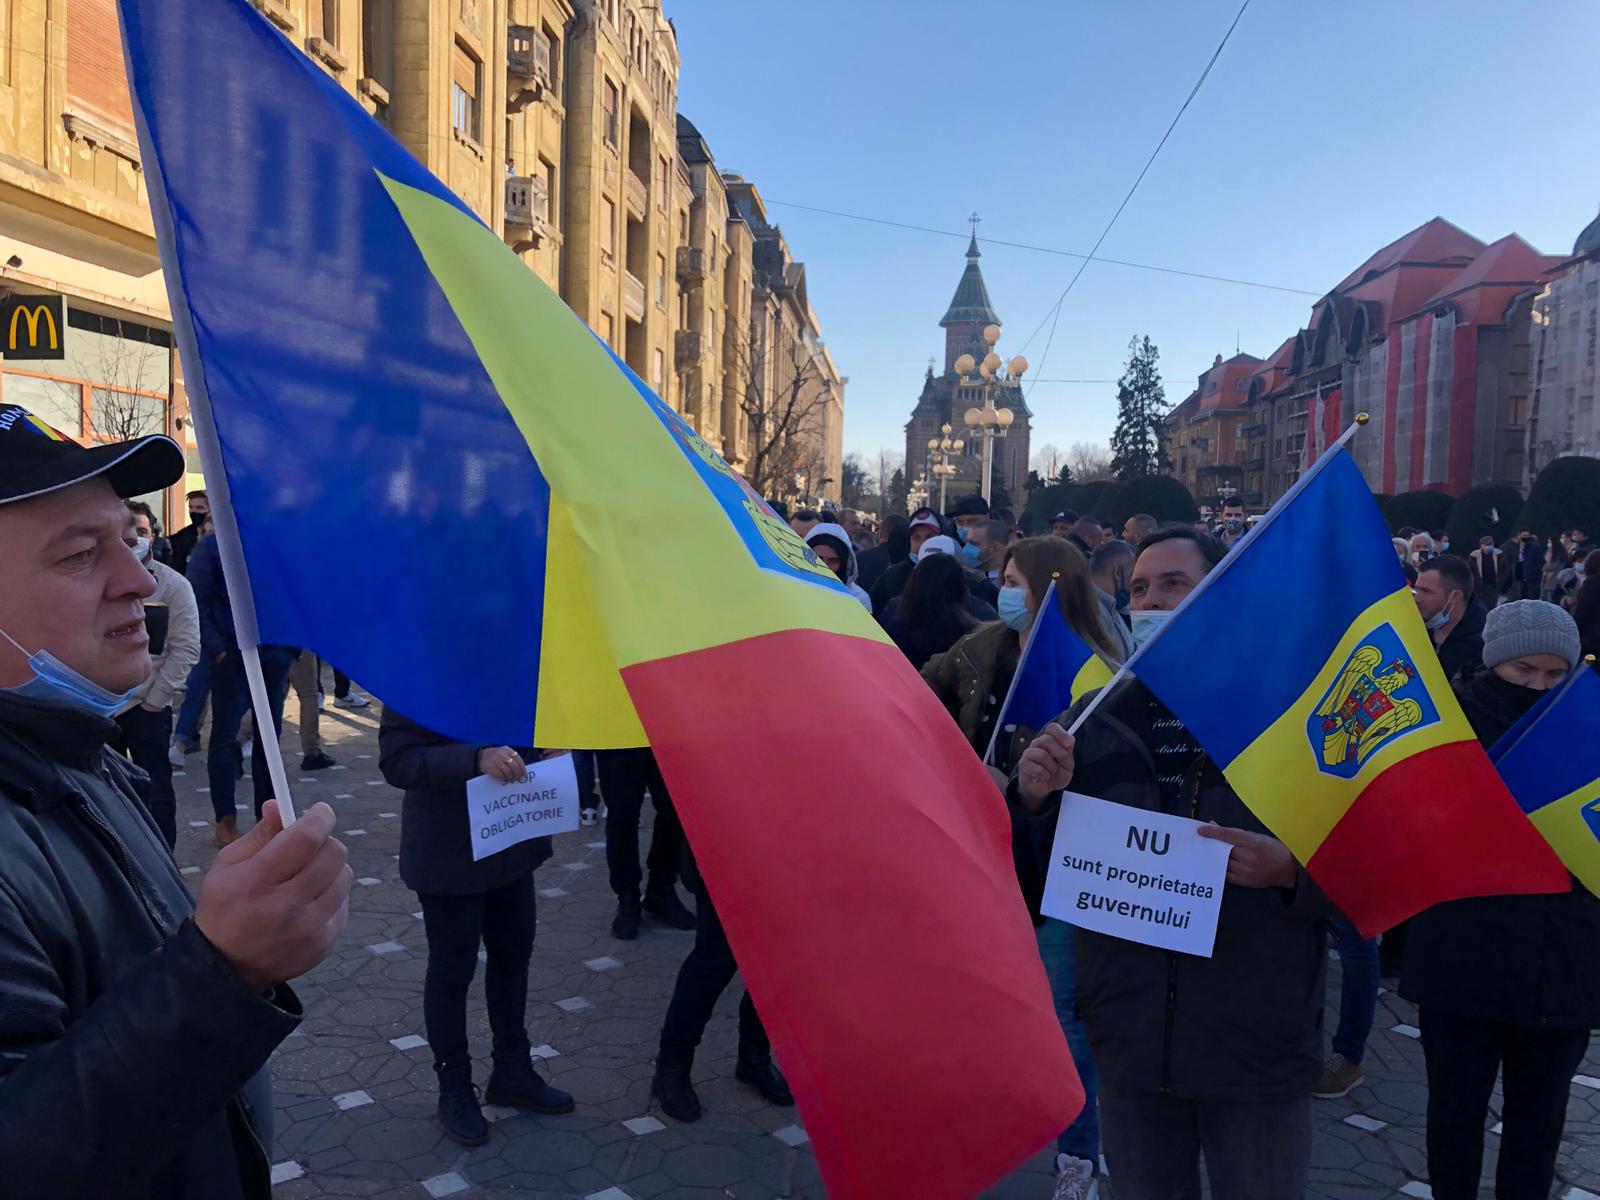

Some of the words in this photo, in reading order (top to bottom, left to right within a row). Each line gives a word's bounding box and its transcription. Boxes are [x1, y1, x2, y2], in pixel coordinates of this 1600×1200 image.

[483, 788, 558, 815] VACCINARE
[480, 807, 564, 839] OBLIGATORIE
[1126, 825, 1171, 856] NU
[1062, 855, 1103, 875] sunt
[1106, 865, 1213, 899] proprietatea
[1076, 891, 1191, 929] guvernului
